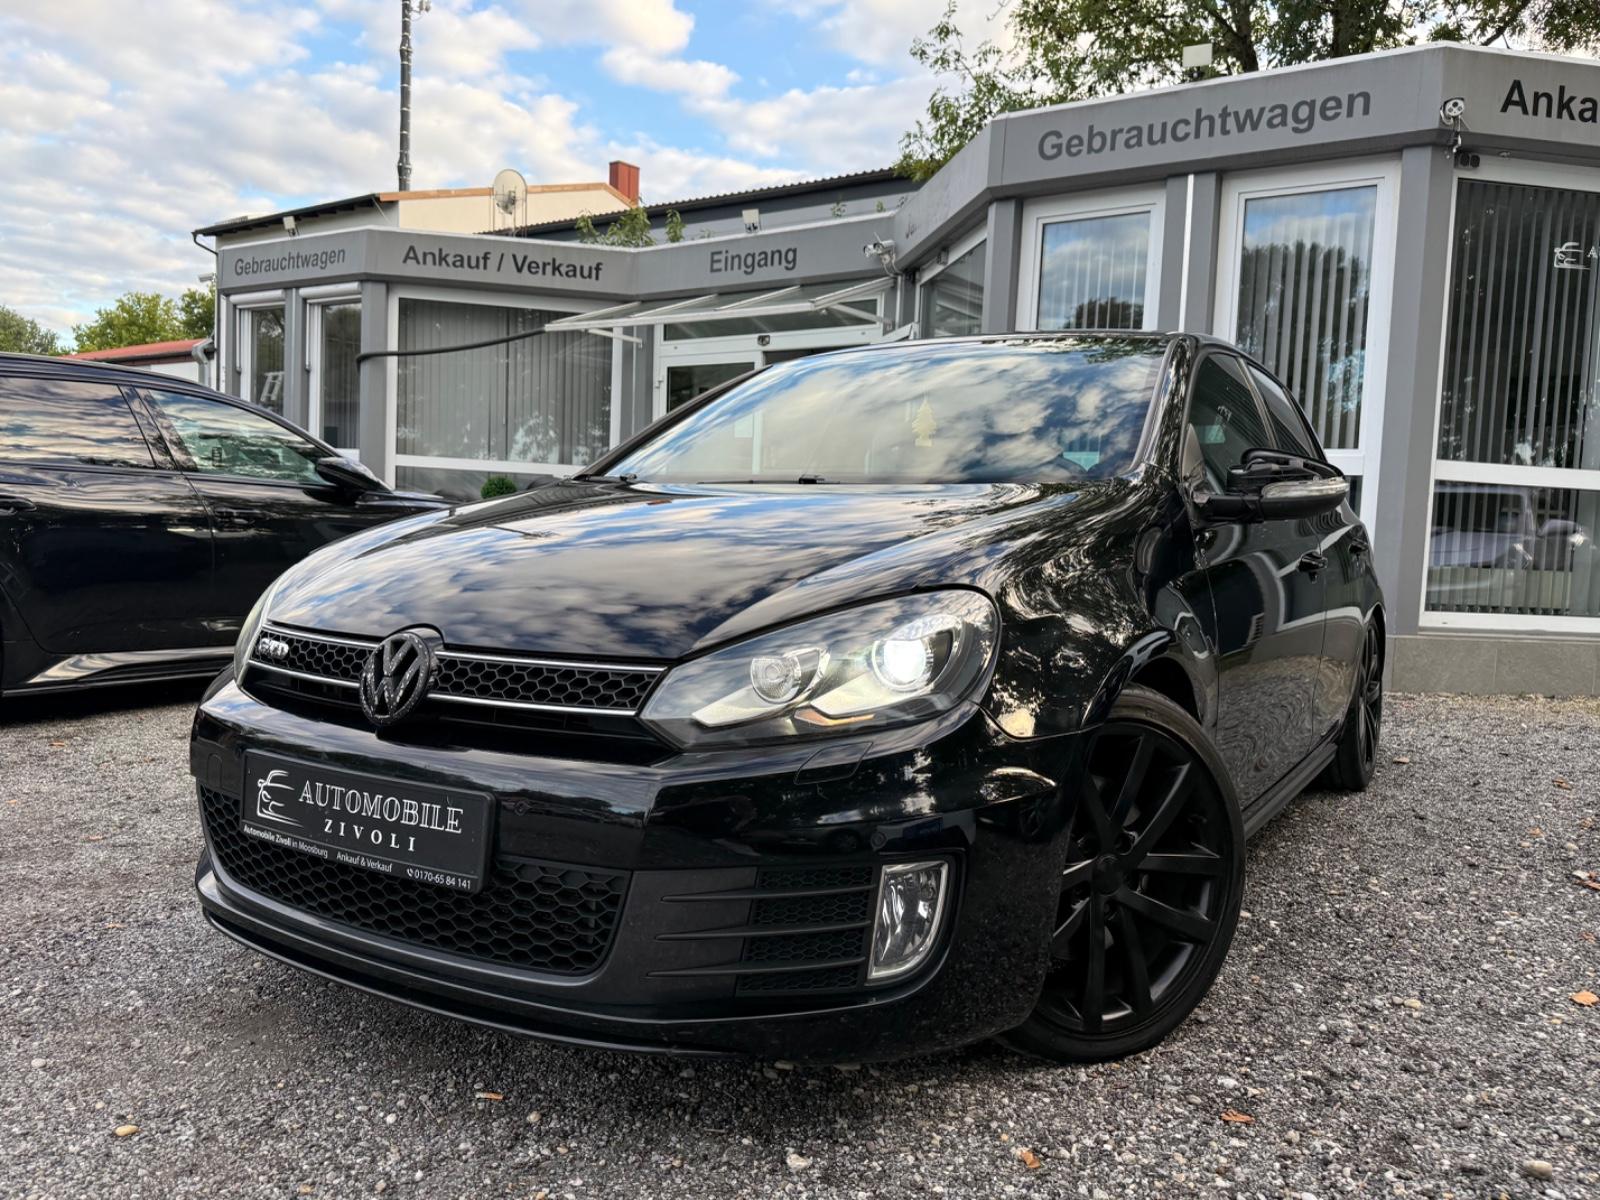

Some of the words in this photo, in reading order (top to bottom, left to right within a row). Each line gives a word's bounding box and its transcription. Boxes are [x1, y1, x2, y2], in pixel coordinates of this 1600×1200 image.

[1500, 79, 1598, 123] Anka
[1037, 90, 1372, 161] Gebrauchtwagen
[234, 247, 346, 277] Gebrauchtwagen
[402, 244, 492, 272] Ankauf
[496, 253, 504, 273] /
[512, 253, 603, 282] Verkauf
[709, 247, 798, 275] Eingang
[299, 780, 464, 834] AUTOMOBILE
[243, 824, 275, 842] Automobile
[275, 834, 291, 846] Zivoli
[299, 841, 328, 859] Moosburg
[324, 818, 416, 852] ZIVOLI
[336, 851, 361, 865] Ankauf
[366, 859, 393, 873] Verkauf
[414, 869, 445, 884] 0170-65
[446, 876, 455, 886] 84
[457, 878, 471, 889] 141
